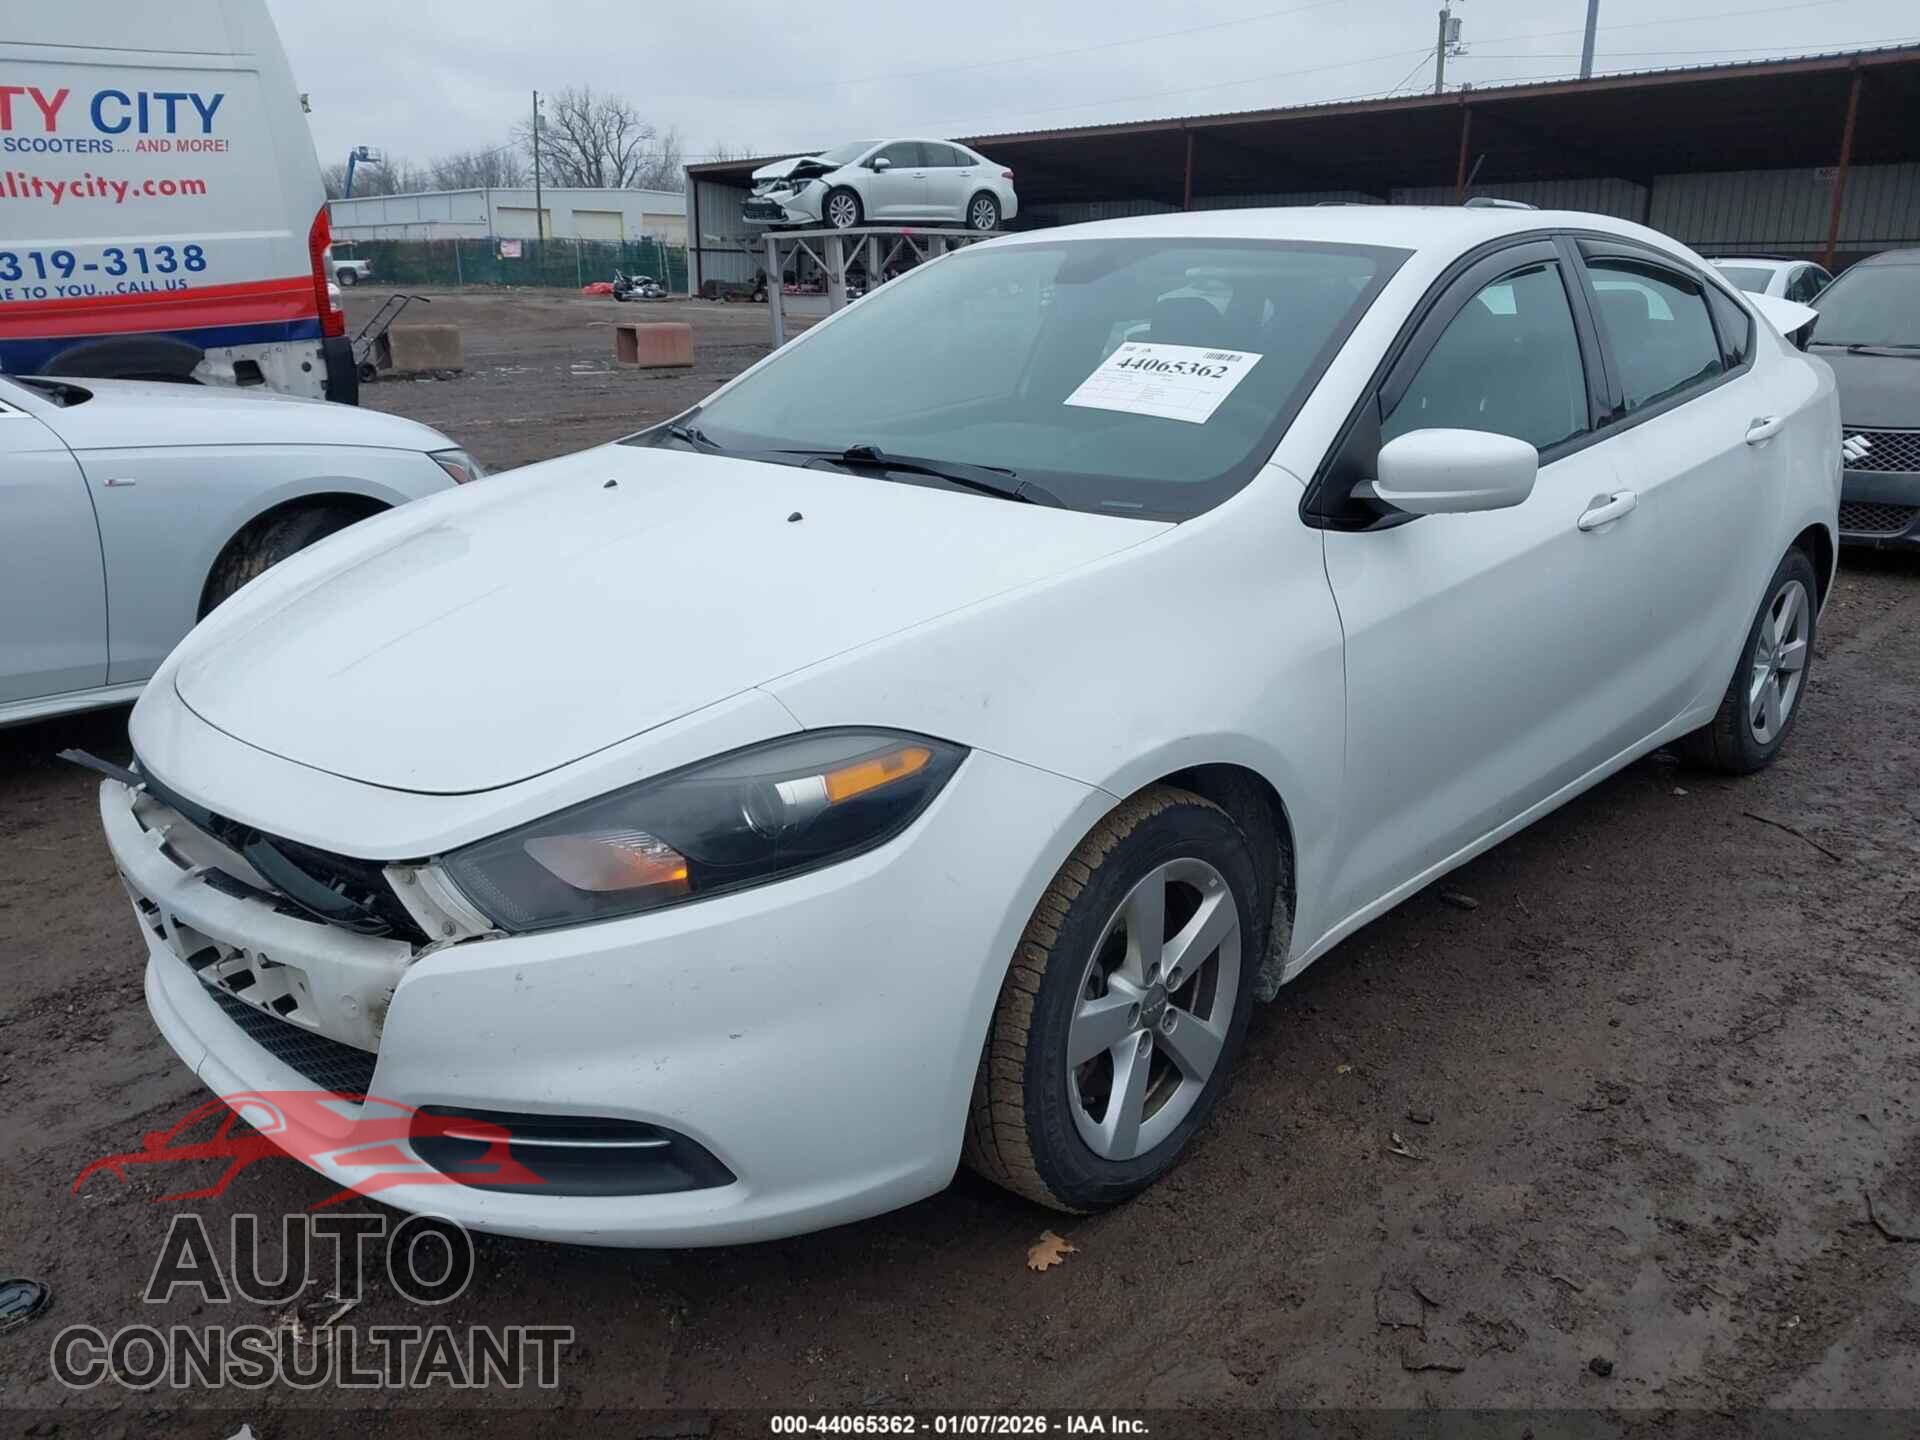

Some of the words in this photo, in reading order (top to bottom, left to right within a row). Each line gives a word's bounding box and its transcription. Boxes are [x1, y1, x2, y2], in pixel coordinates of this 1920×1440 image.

[90, 89, 225, 134] CITY
[135, 139, 171, 153] AND
[176, 139, 230, 153] MORE!
[0, 244, 207, 281] 319-3138
[21, 286, 47, 299] TO
[165, 278, 188, 292] US
[1116, 356, 1228, 379] 44065362
